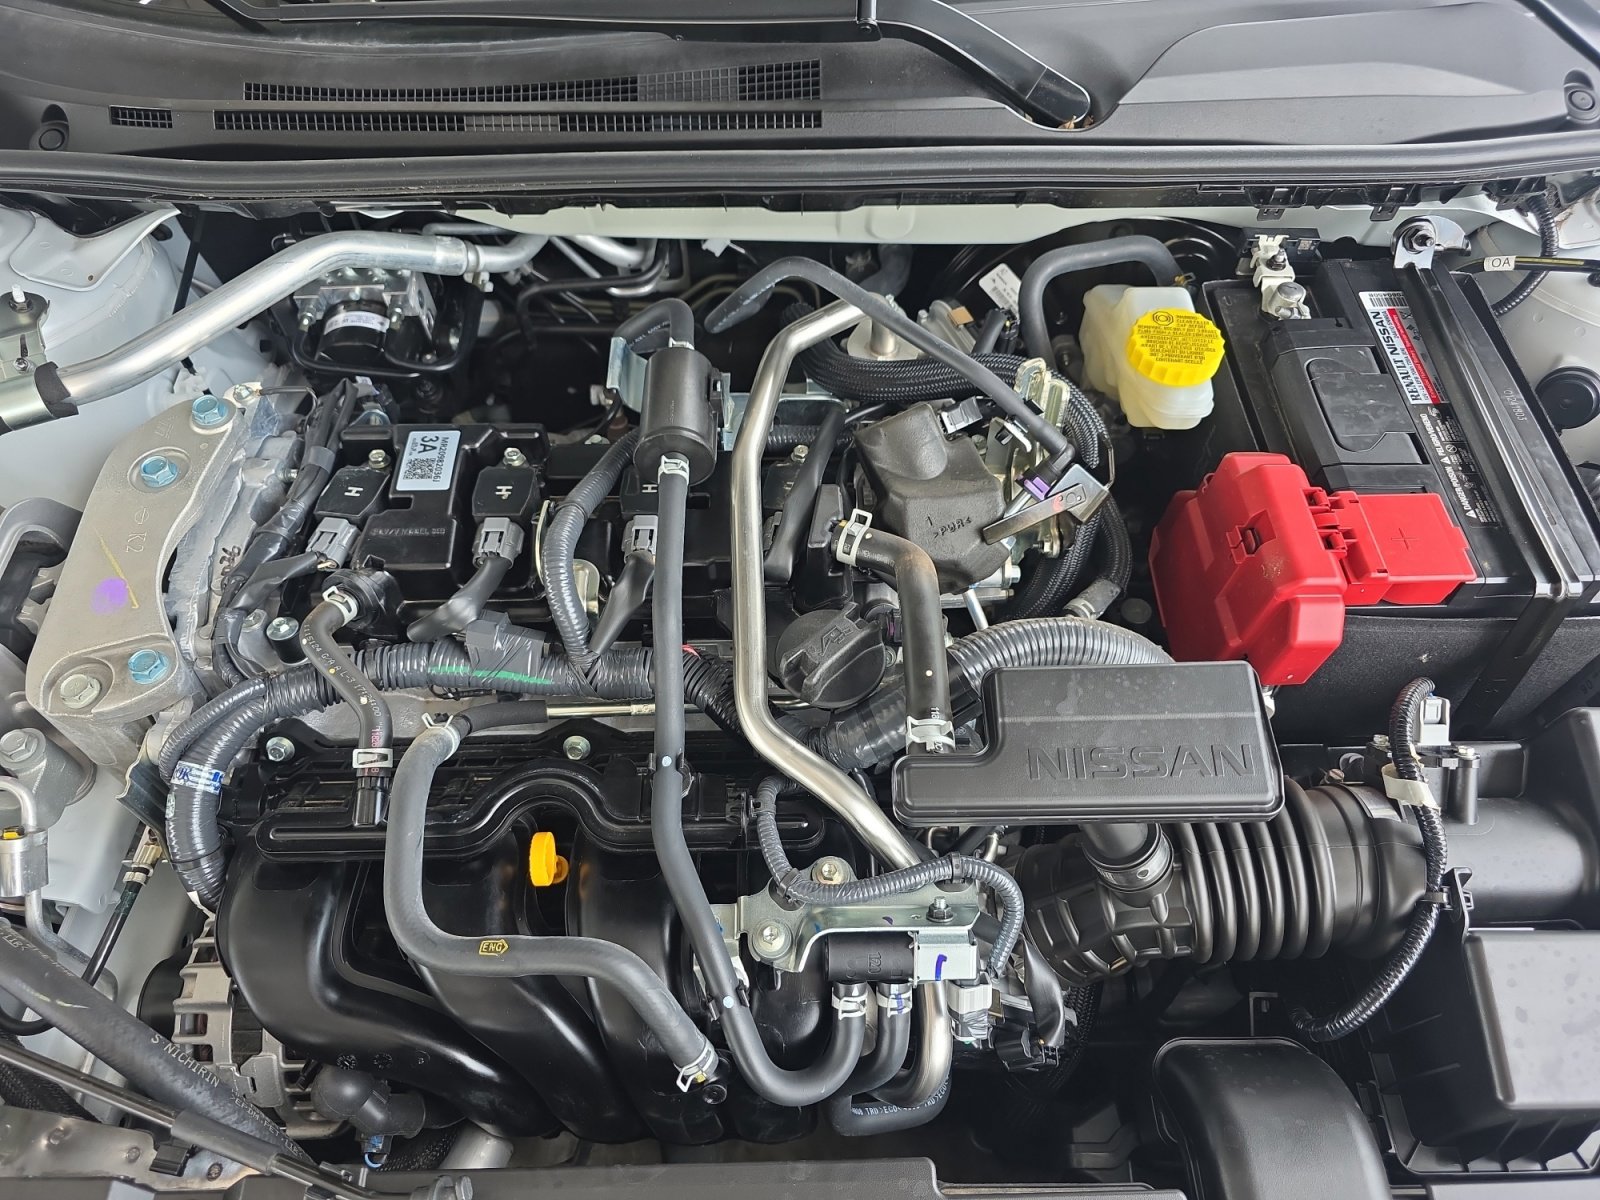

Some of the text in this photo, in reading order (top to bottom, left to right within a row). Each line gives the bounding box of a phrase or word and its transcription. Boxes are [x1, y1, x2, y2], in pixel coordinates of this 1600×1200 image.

[1371, 311, 1400, 355] NISSAN
[1394, 359, 1422, 401] RENAULT
[418, 436, 440, 454] 3A
[1027, 744, 1256, 780] NISSAN
[482, 942, 502, 952] ENG
[163, 1042, 220, 1088] NICHIRIN
